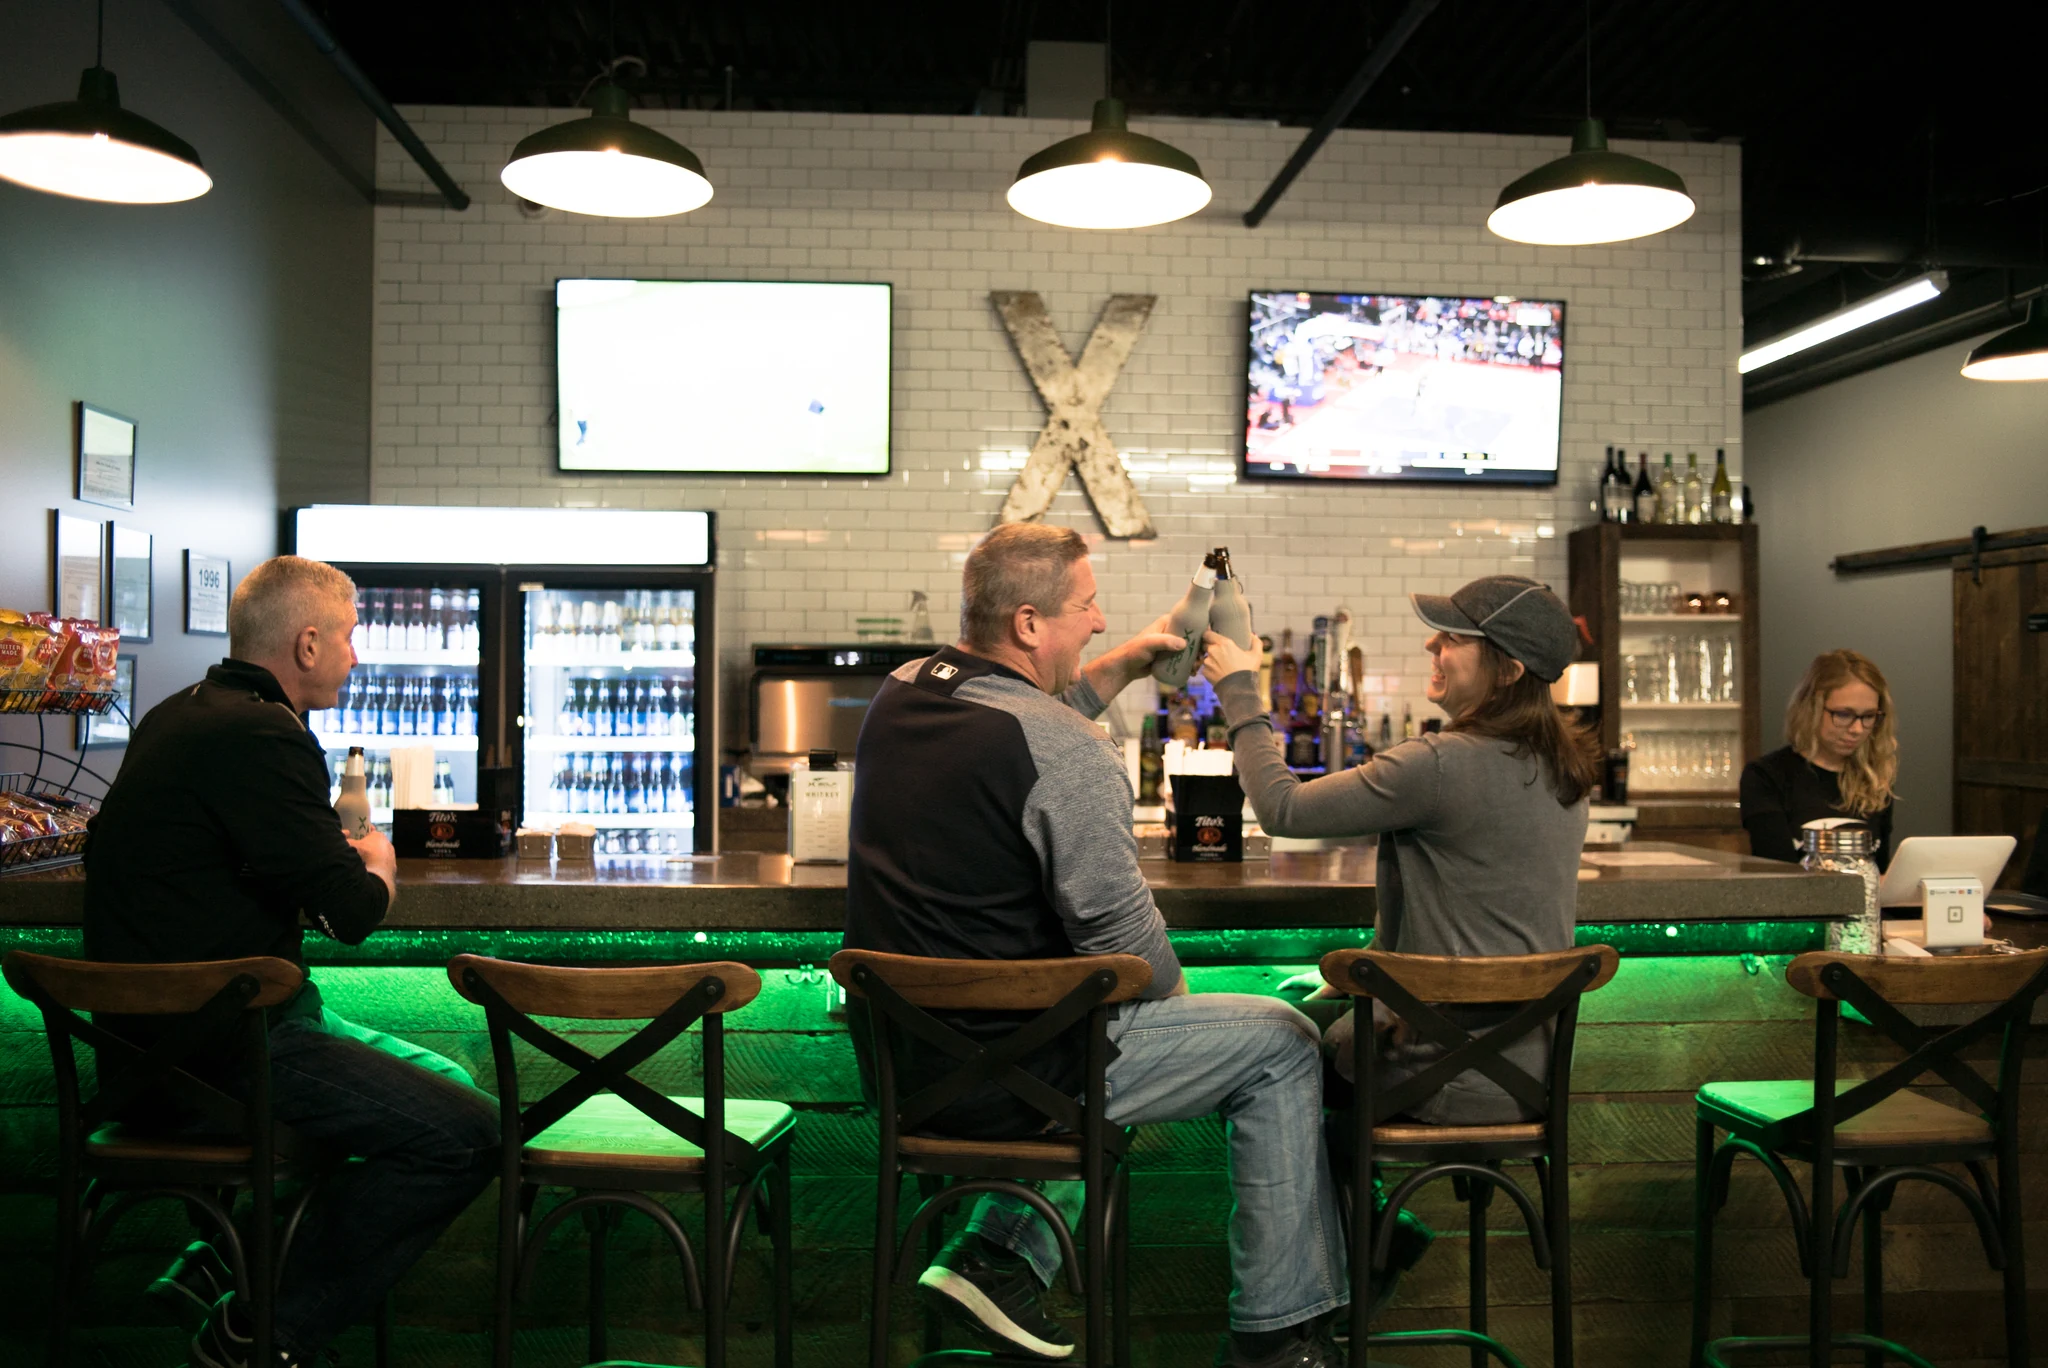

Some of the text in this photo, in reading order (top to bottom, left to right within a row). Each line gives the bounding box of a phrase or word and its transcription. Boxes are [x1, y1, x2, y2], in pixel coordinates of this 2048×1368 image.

[199, 568, 220, 588] 1996
[428, 811, 458, 822] Tito's
[1194, 815, 1225, 827] Tito's
